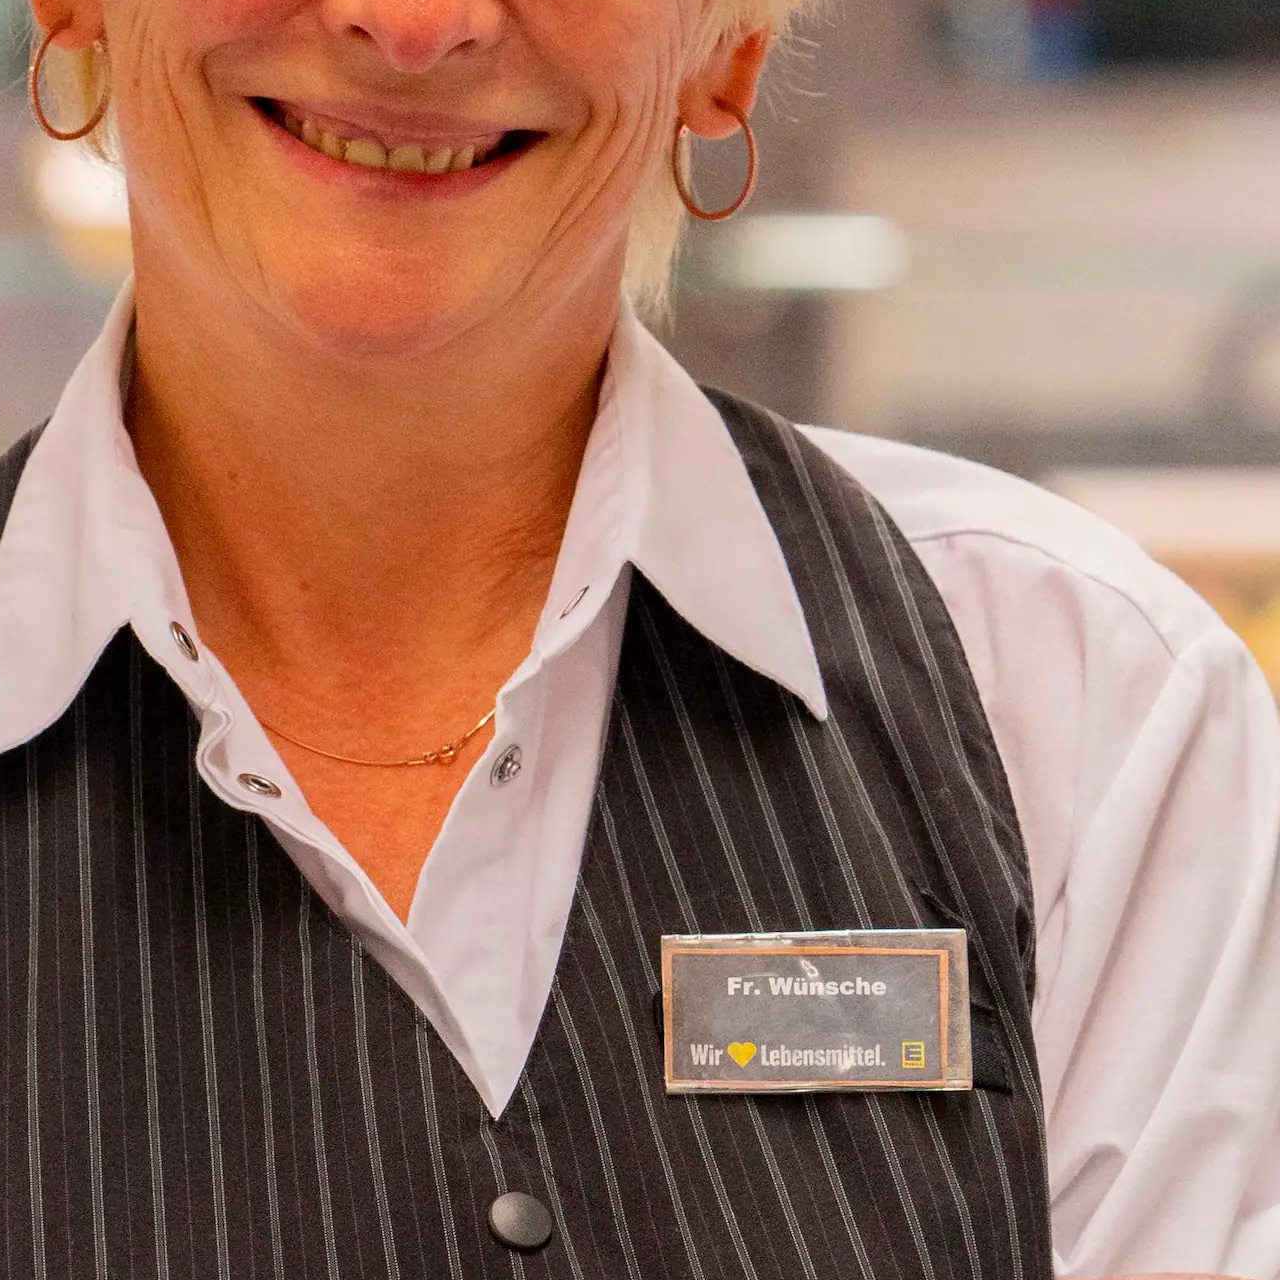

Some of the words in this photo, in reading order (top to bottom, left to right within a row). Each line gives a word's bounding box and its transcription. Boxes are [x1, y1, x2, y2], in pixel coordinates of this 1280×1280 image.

[727, 977, 761, 996] Fr.
[769, 976, 887, 996] Wünsche
[690, 1043, 723, 1066] Wir
[760, 1043, 886, 1067] Lebensmittel.
